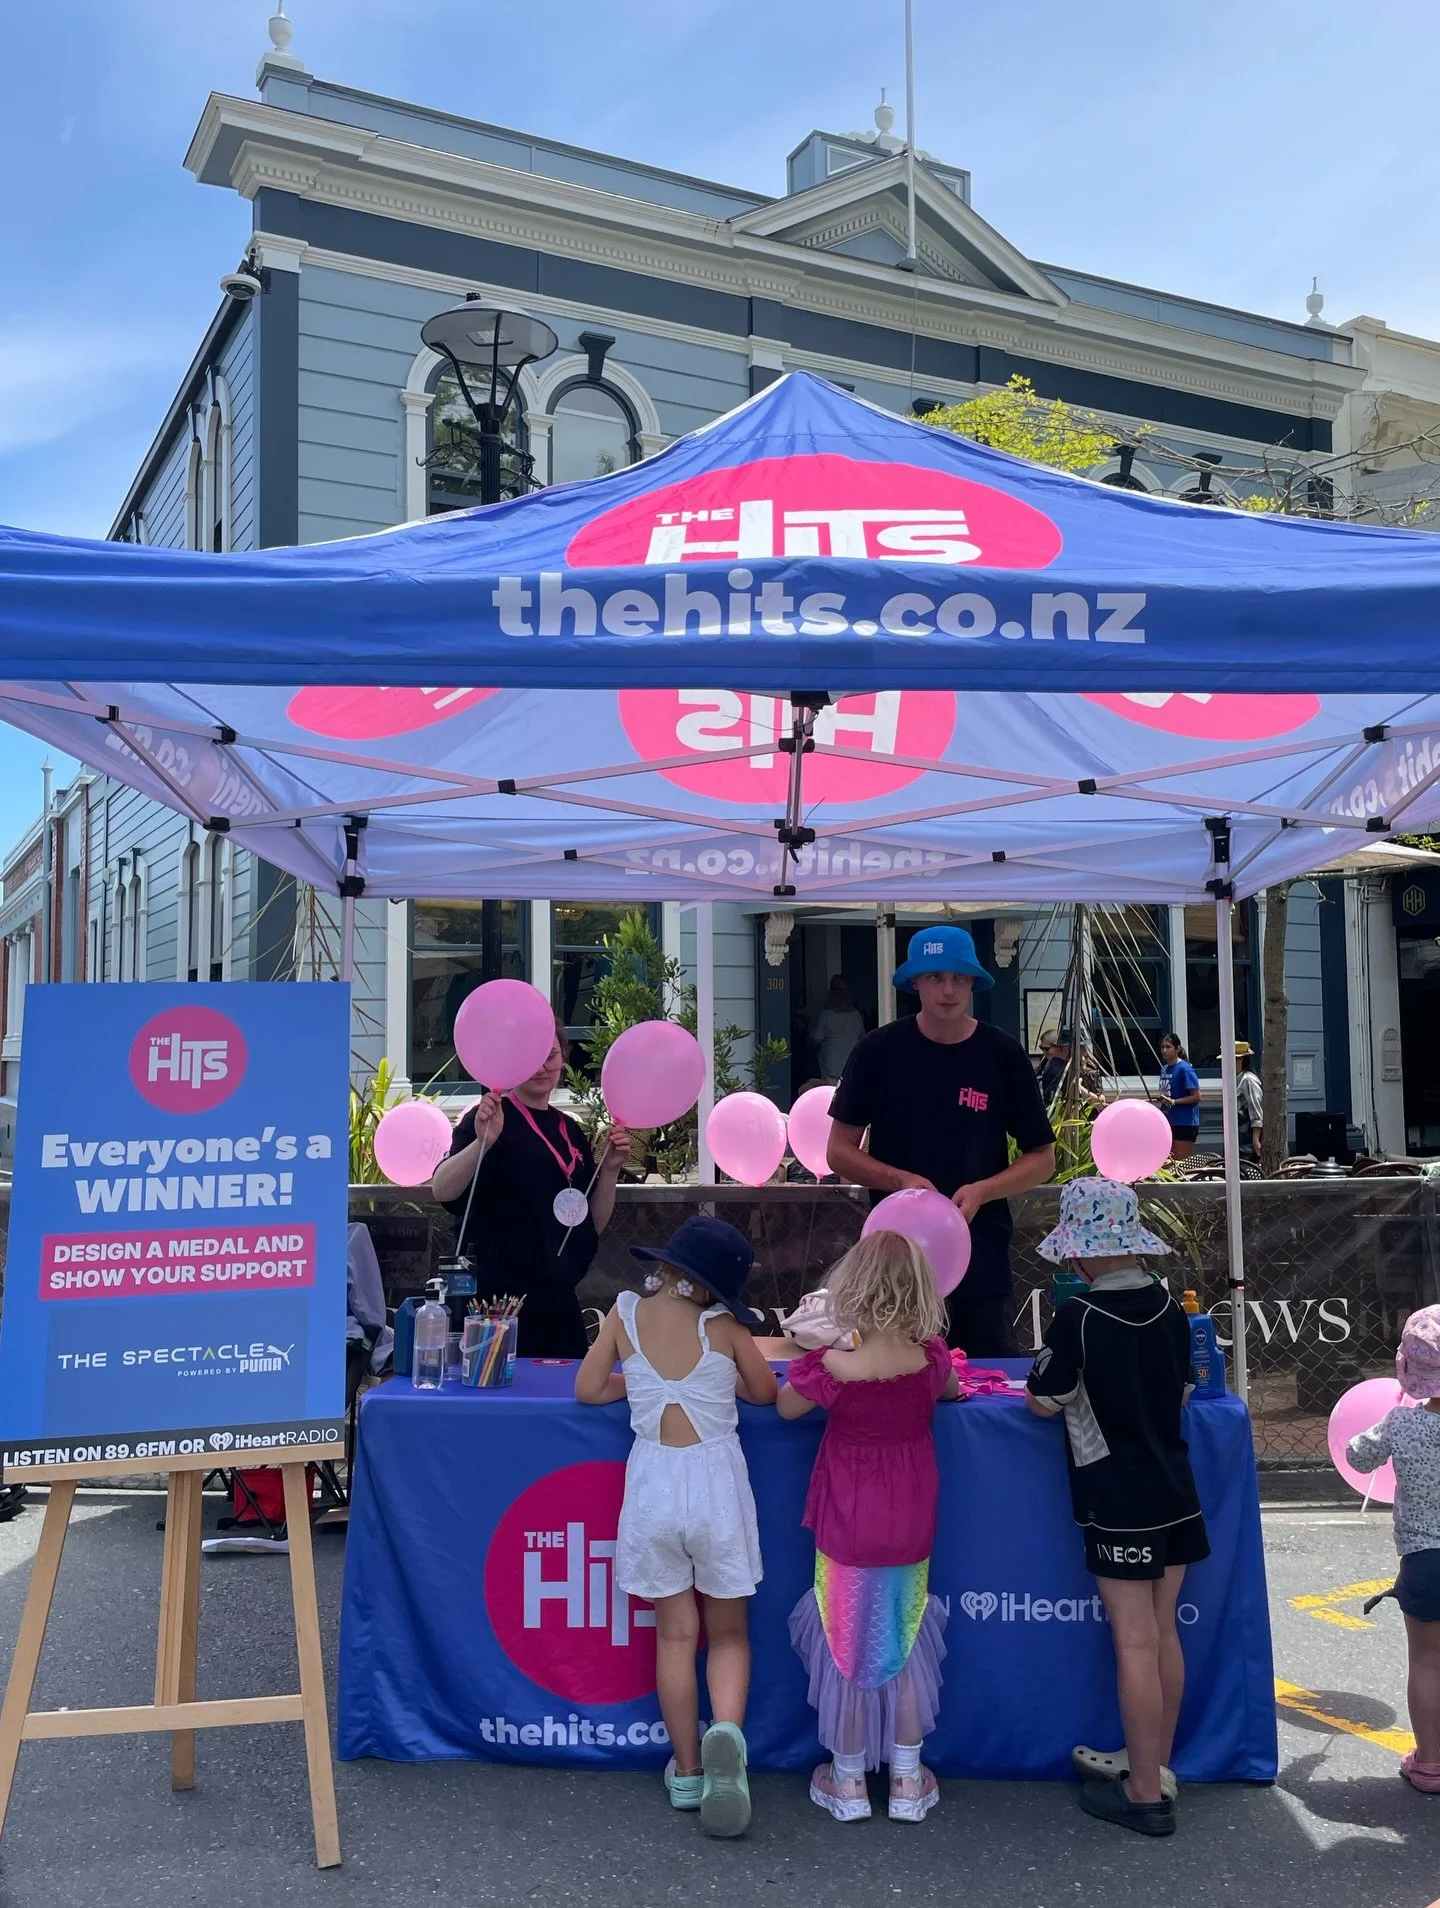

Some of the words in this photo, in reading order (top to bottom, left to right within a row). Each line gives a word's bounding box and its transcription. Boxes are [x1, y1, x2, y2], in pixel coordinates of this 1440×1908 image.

[656, 508, 735, 525] THE
[491, 568, 1147, 645] thehits.co.nz
[767, 977, 784, 990] 300
[150, 1037, 171, 1046] THE
[41, 1126, 298, 1174] Everyone's
[305, 1133, 332, 1160] a
[74, 1172, 294, 1214] WINNER!
[54, 1241, 142, 1263] DESIGN
[146, 1240, 164, 1259] A
[168, 1236, 250, 1258] MEDAL
[253, 1234, 304, 1254] AND
[49, 1268, 126, 1290] SHOW
[130, 1264, 196, 1286] YOUR
[199, 1258, 308, 1282] SUPPORT
[57, 1352, 108, 1370] THE
[122, 1342, 265, 1366] SPECTACLE
[177, 1367, 221, 1377] POWERED
[225, 1366, 237, 1374] BY
[239, 1357, 283, 1374] PUMA
[2, 1446, 71, 1467] LISTEN
[73, 1444, 102, 1462] ON
[105, 1440, 176, 1460] 89.6FM
[178, 1438, 205, 1454] OR
[234, 1427, 339, 1449] iHeartRADIO
[524, 1531, 565, 1548] THE
[1096, 1543, 1153, 1564] INEOS
[523, 1521, 657, 1647] HIT
[1001, 1591, 1200, 1625] iHeartO
